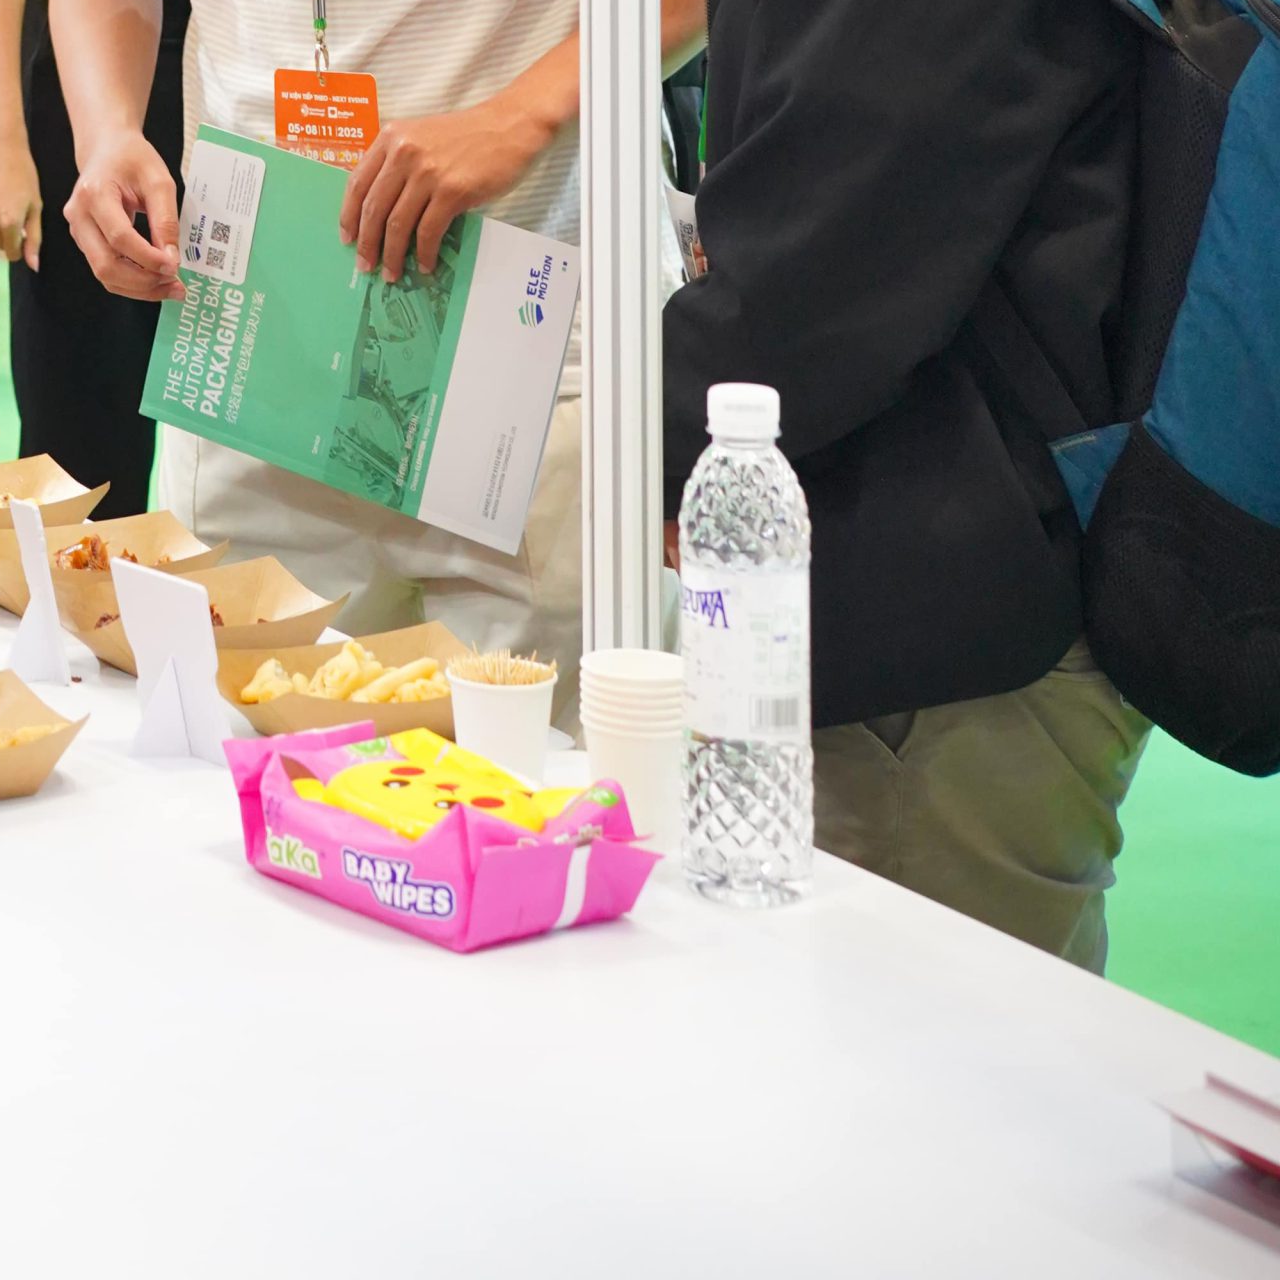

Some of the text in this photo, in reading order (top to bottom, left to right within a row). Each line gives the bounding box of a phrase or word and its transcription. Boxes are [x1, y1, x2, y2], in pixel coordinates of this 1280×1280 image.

[338, 127, 364, 138] 2025
[189, 223, 198, 243] ELE
[197, 214, 207, 245] MOTION
[526, 267, 541, 297] ELE
[538, 254, 553, 301] MOTION
[163, 278, 202, 402] THE SOLUTION
[199, 287, 245, 418] PACKAGING
[181, 309, 216, 411] AUTOMATIC
[268, 832, 320, 877] aKa
[344, 850, 409, 884] BABY
[373, 880, 454, 917] WIPES
